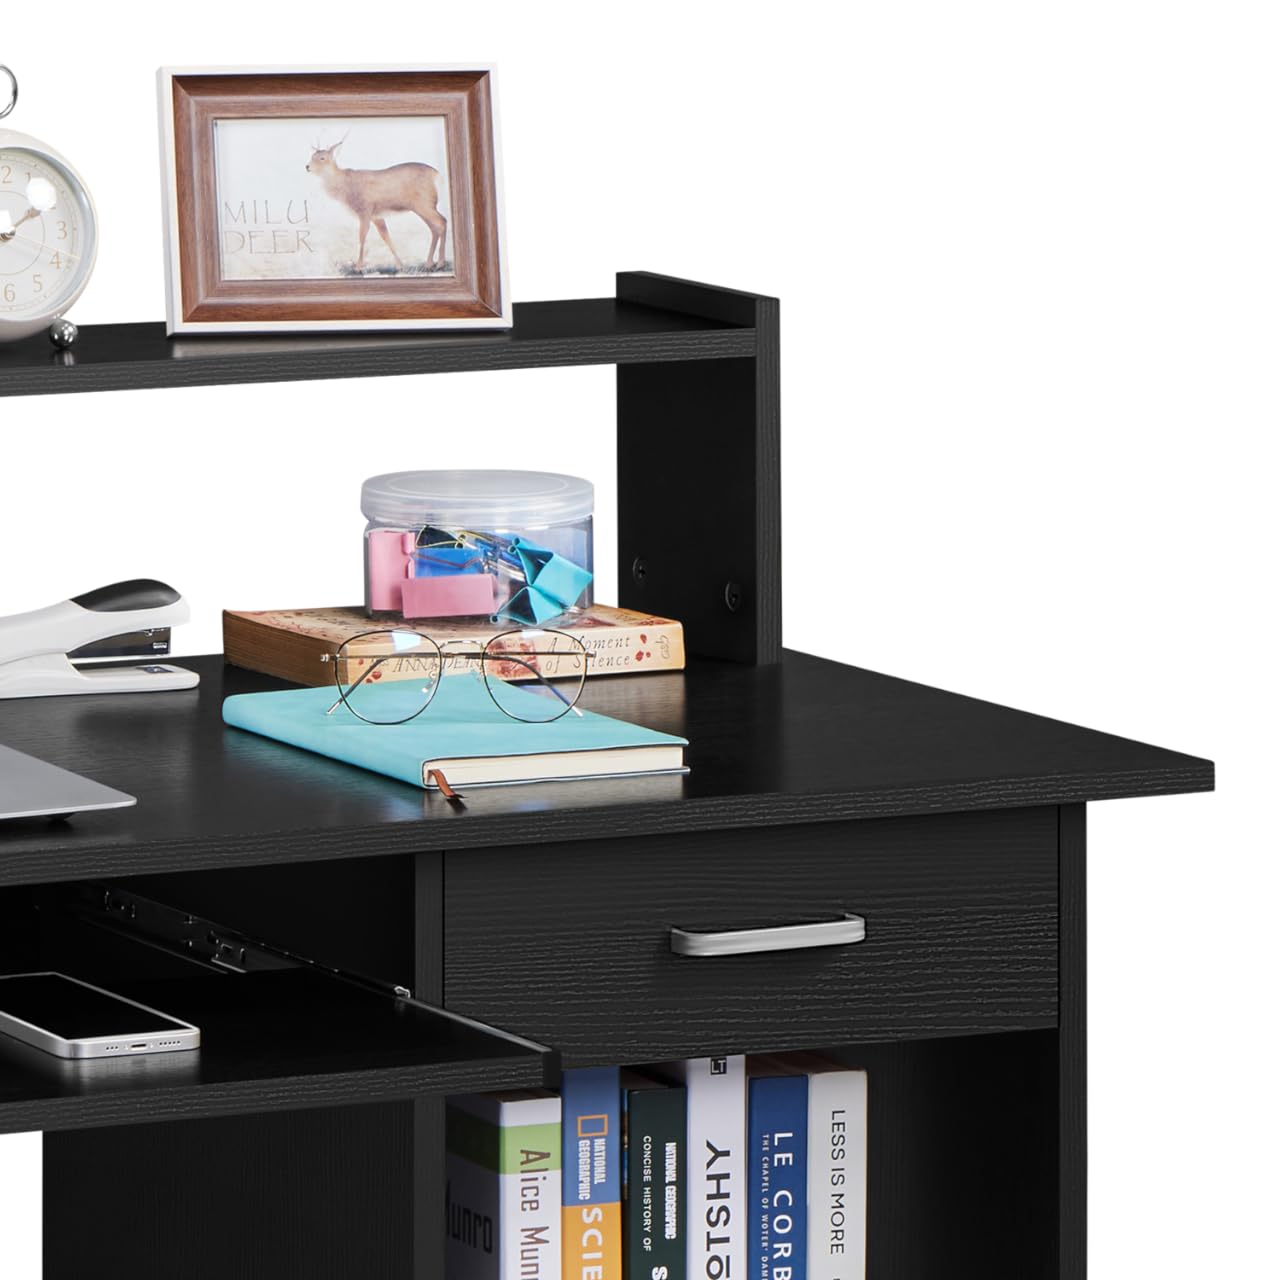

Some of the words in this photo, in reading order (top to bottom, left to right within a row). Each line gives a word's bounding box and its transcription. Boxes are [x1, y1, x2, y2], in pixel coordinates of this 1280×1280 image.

[224, 199, 310, 225] MILU
[56, 221, 67, 240] 3
[223, 229, 316, 255] DEER
[50, 251, 61, 269] 4
[3, 283, 16, 302] 6
[32, 274, 43, 293] 5
[568, 635, 631, 651] Moment
[573, 654, 631, 669] Slence
[761, 1134, 770, 1151] THE
[773, 1132, 793, 1168] LE
[831, 1110, 846, 1161] LESS
[578, 1139, 591, 1200] GEOGRAPHIC
[594, 1138, 606, 1185] NATIONAL
[642, 1135, 652, 1182] CONCISE
[664, 1142, 677, 1183] NATIONAL
[520, 1149, 552, 1213] Alice
[761, 1156, 769, 1193] CHAPEL
[830, 1167, 845, 1186] IS
[446, 1180, 493, 1254] unro
[642, 1187, 652, 1233] HISTORY
[664, 1185, 677, 1240] GEOGRAPHIC
[761, 1198, 769, 1210] OF
[830, 1193, 845, 1255] MORE
[642, 1239, 652, 1252] OF
